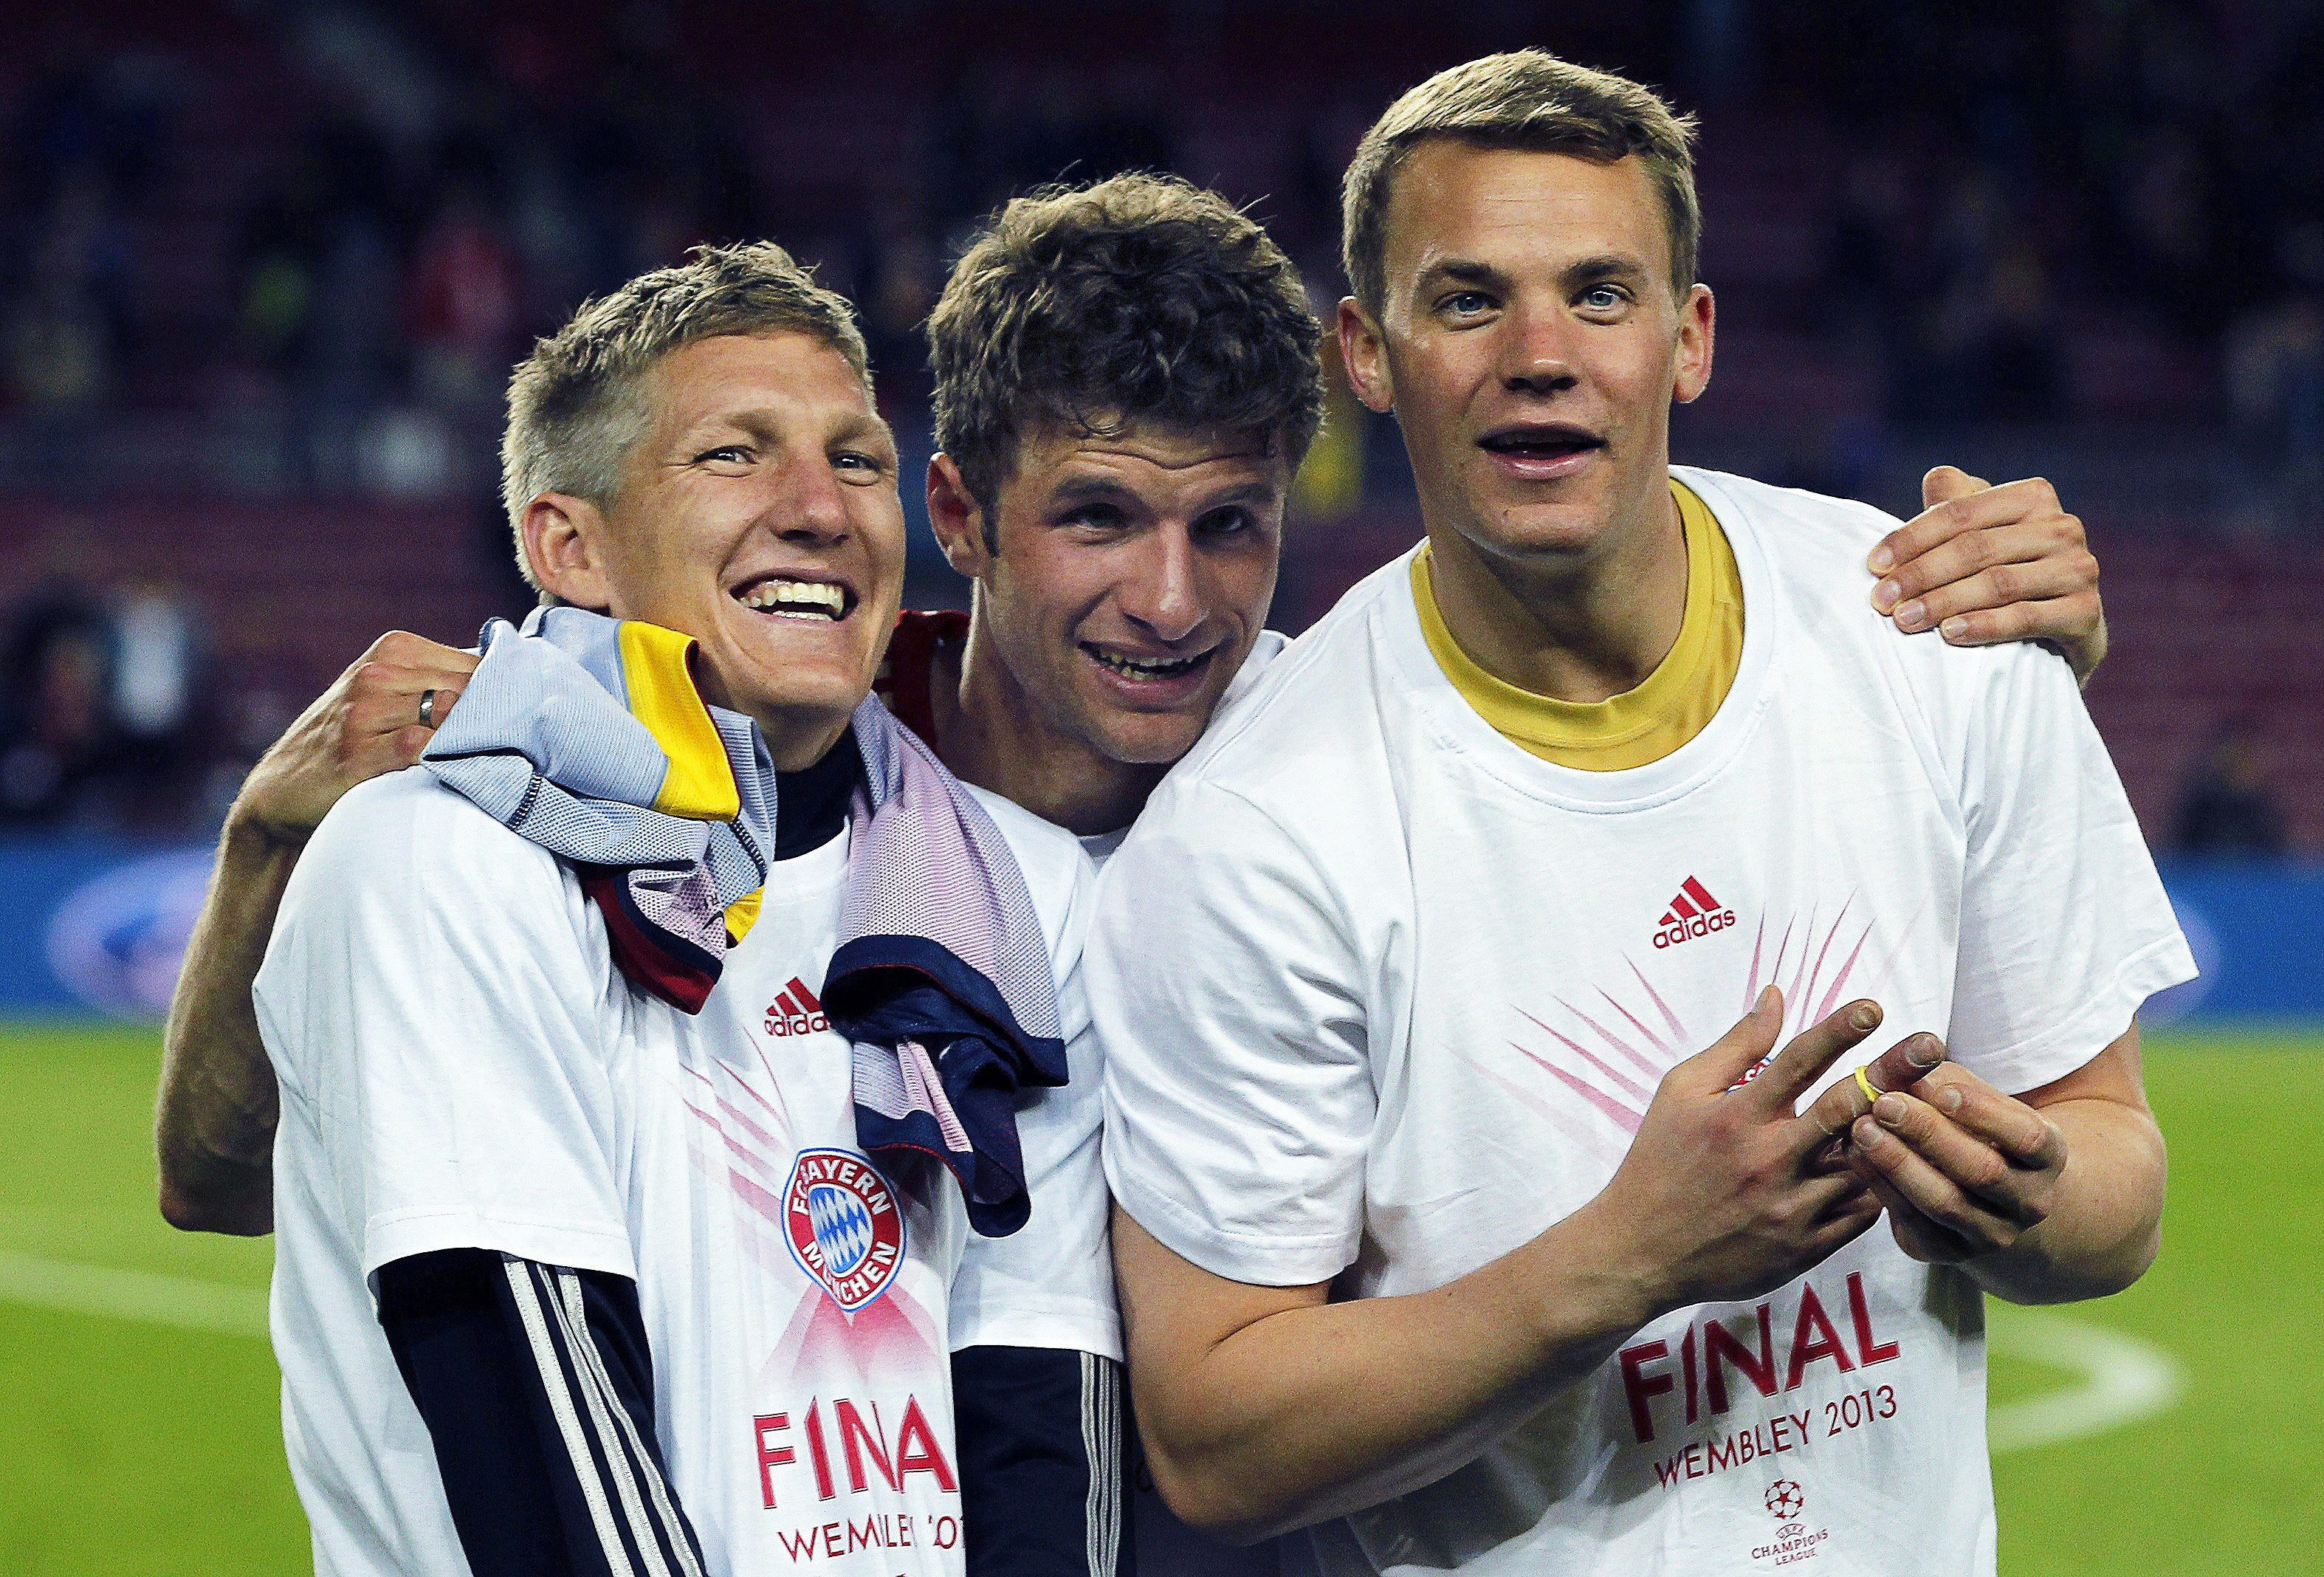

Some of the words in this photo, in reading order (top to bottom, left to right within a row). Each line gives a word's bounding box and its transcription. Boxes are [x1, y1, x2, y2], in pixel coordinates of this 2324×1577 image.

[1653, 910, 1736, 949] adidas
[765, 1013, 829, 1037] adida
[1619, 1271, 1901, 1443] FINAL
[752, 1394, 958, 1509] FINA
[1654, 1409, 1810, 1491] WEMBLEY
[1825, 1385, 1897, 1437] 2013
[777, 1514, 917, 1563] WEMLE
